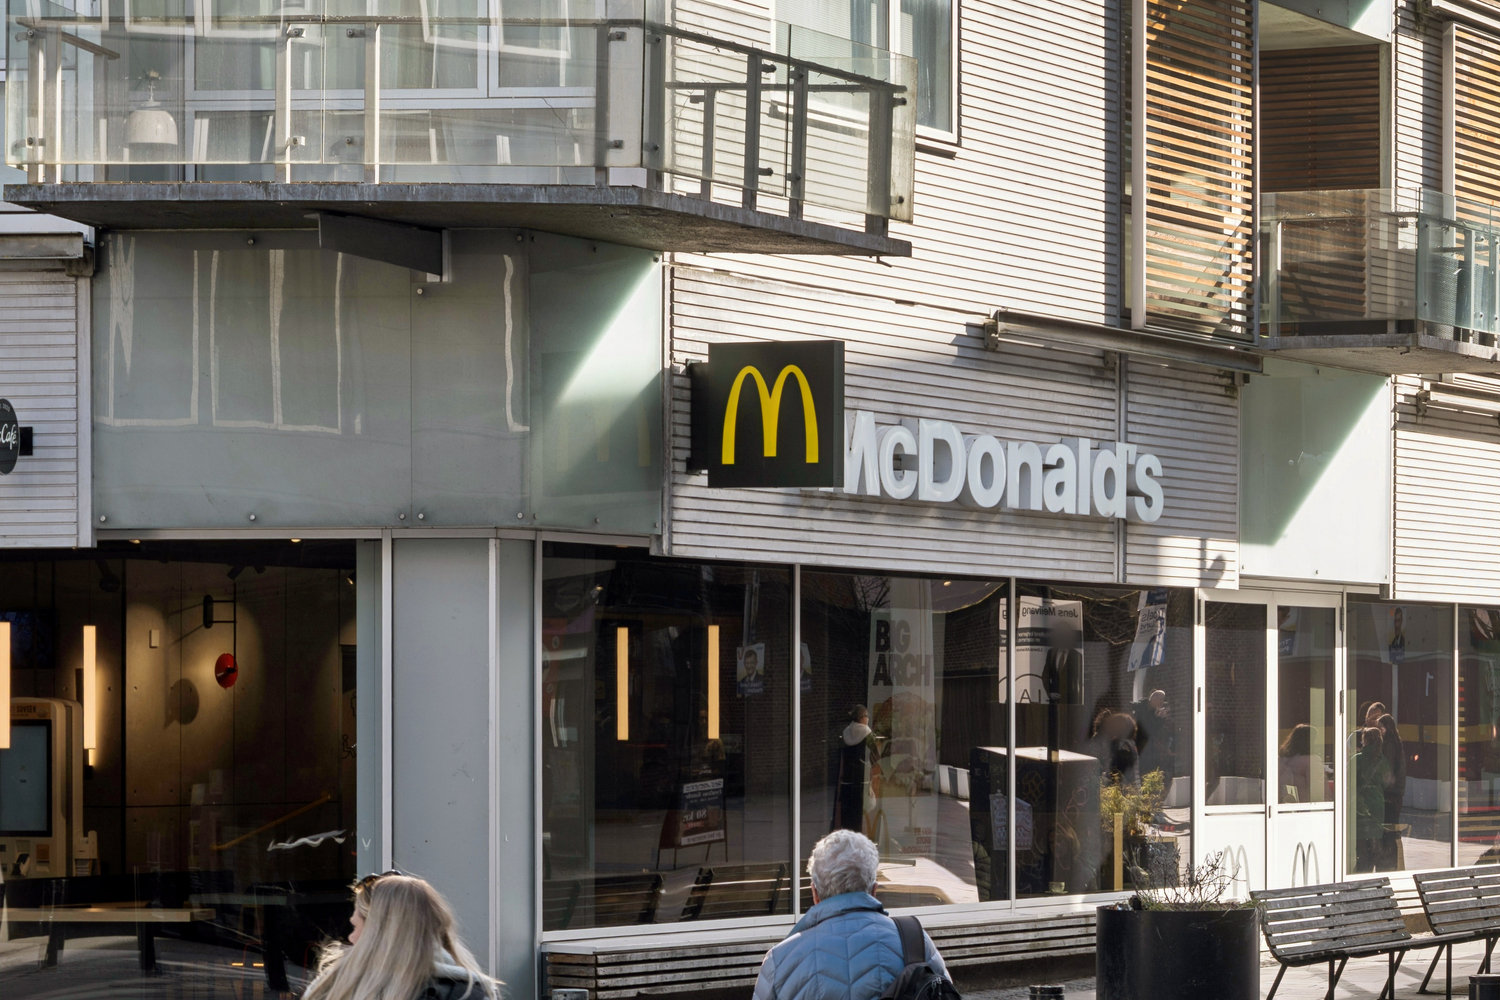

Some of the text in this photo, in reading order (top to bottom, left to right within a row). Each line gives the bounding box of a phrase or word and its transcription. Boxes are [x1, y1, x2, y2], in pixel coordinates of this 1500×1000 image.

[0, 423, 17, 450] Café
[876, 619, 911, 652] BIG
[872, 653, 930, 687] ARCH
